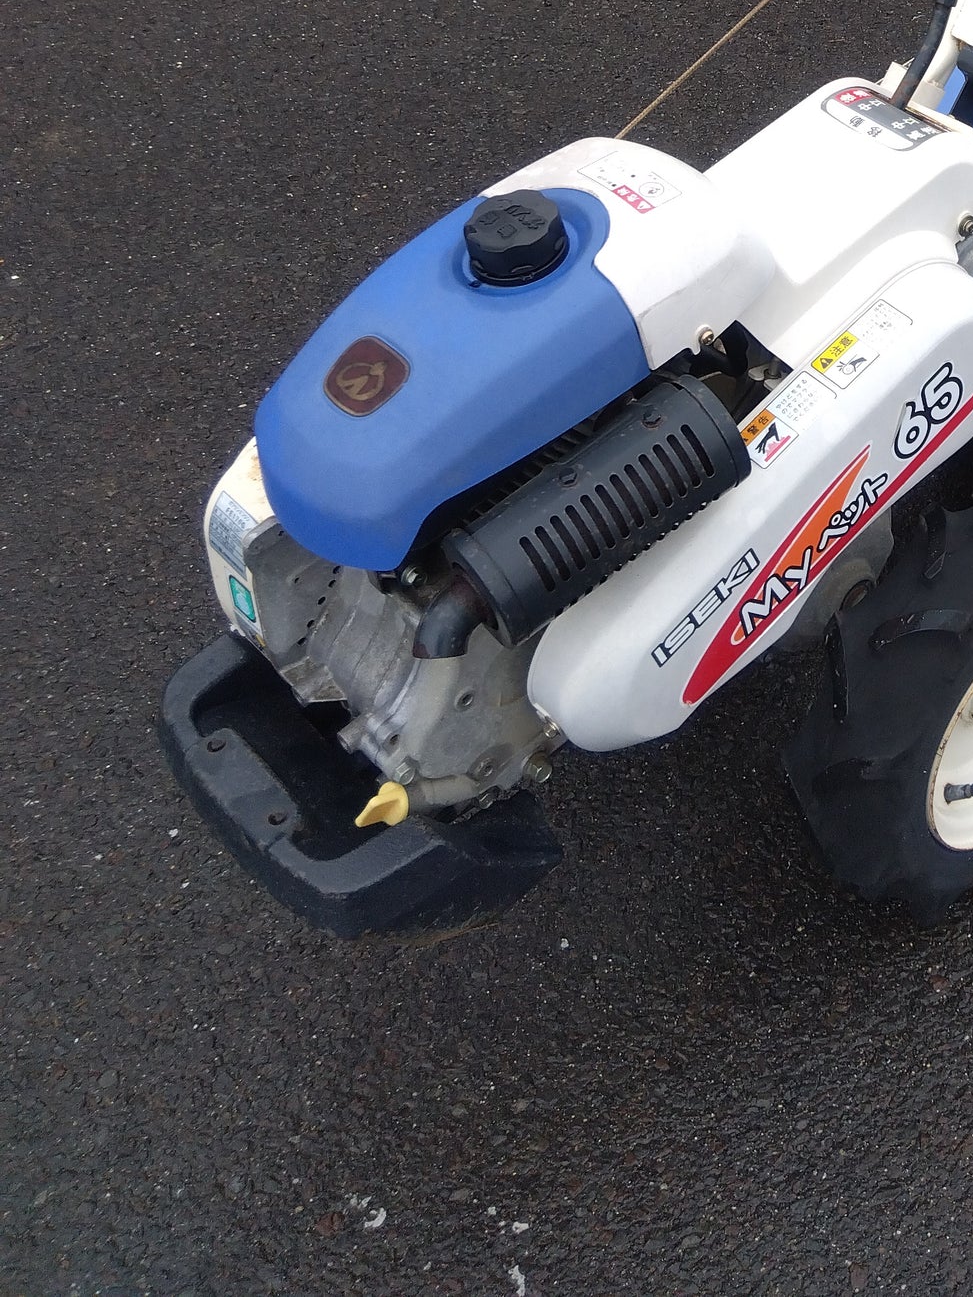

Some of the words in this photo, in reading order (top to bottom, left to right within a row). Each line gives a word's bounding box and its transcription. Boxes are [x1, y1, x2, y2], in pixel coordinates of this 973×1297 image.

[858, 99, 886, 111] 中立
[891, 117, 920, 129] 中立
[830, 336, 853, 357] 注意
[893, 361, 965, 460] 65
[747, 415, 769, 435] 警告
[651, 548, 760, 667] ISEKI
